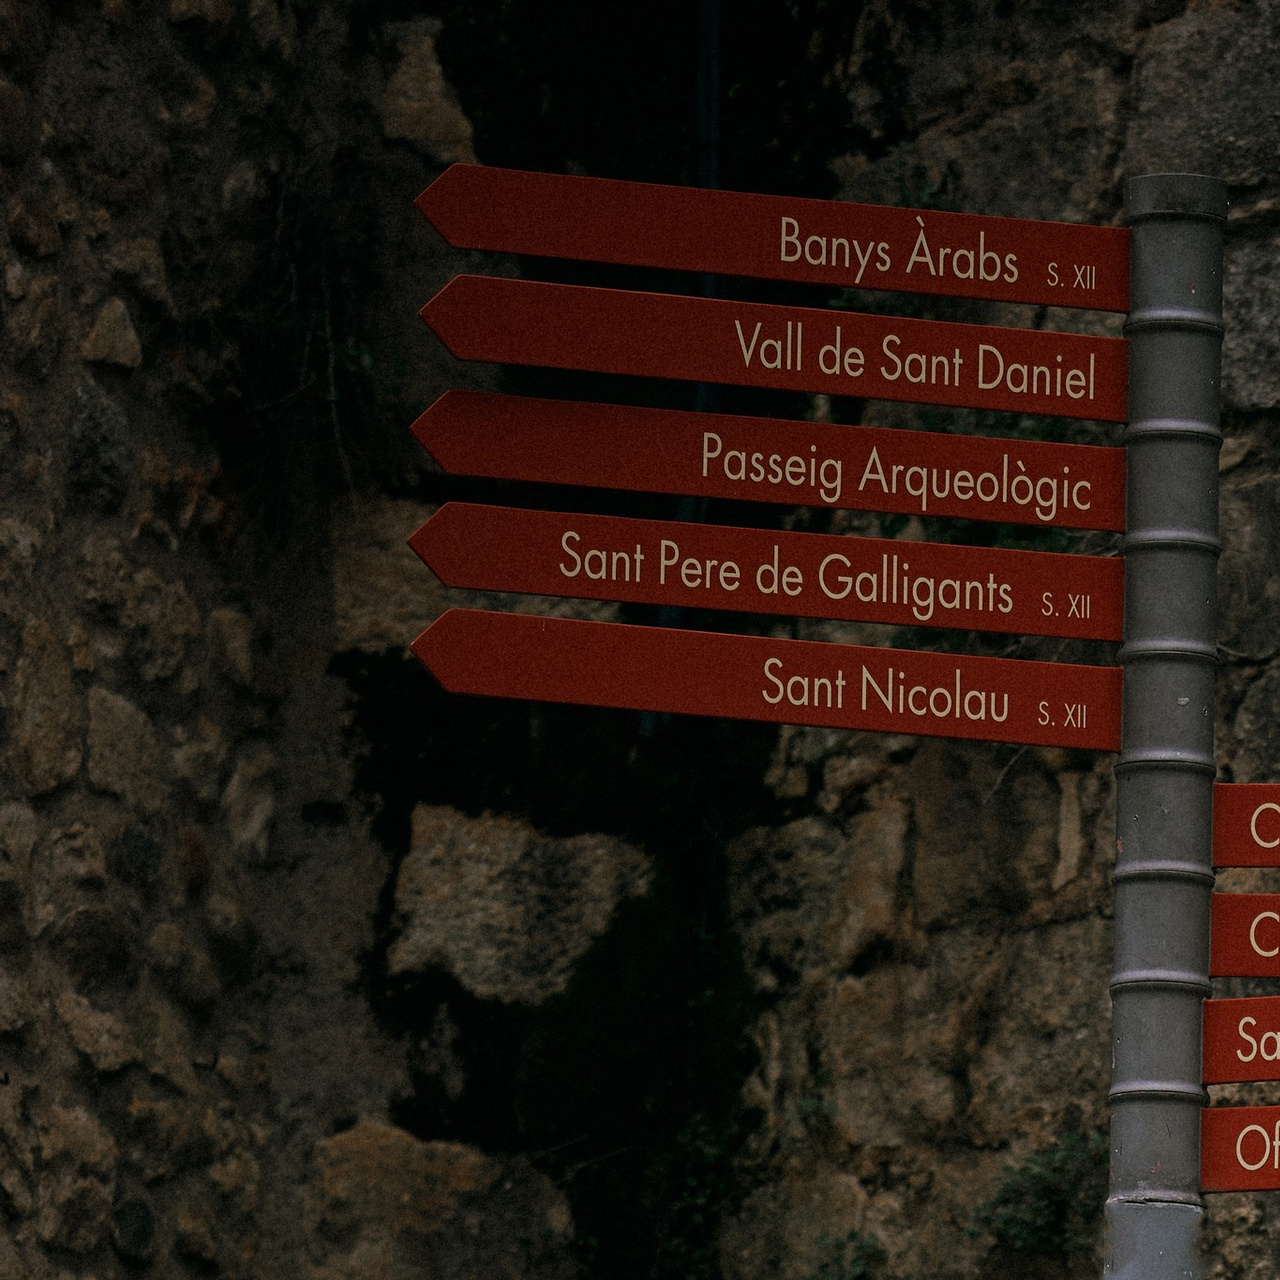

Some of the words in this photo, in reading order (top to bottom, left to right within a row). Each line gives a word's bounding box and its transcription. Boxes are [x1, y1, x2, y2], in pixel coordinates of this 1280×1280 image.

[780, 216, 891, 284] Banys
[905, 215, 1019, 283] Àrabs
[1072, 264, 1096, 290] XII
[734, 319, 803, 371] Vall
[818, 325, 865, 377] de
[880, 334, 964, 387] Sant
[978, 344, 1095, 400] Daniel
[702, 431, 842, 504] Passeig
[858, 445, 1091, 522] Arqueològic
[559, 530, 645, 583] Sant
[660, 539, 741, 591] Pere
[756, 544, 803, 597] de
[818, 553, 1014, 621] Galligants
[1067, 593, 1090, 619] XII
[761, 657, 846, 709] Sant
[861, 664, 1009, 723] Nicolau
[1063, 703, 1087, 729] XII
